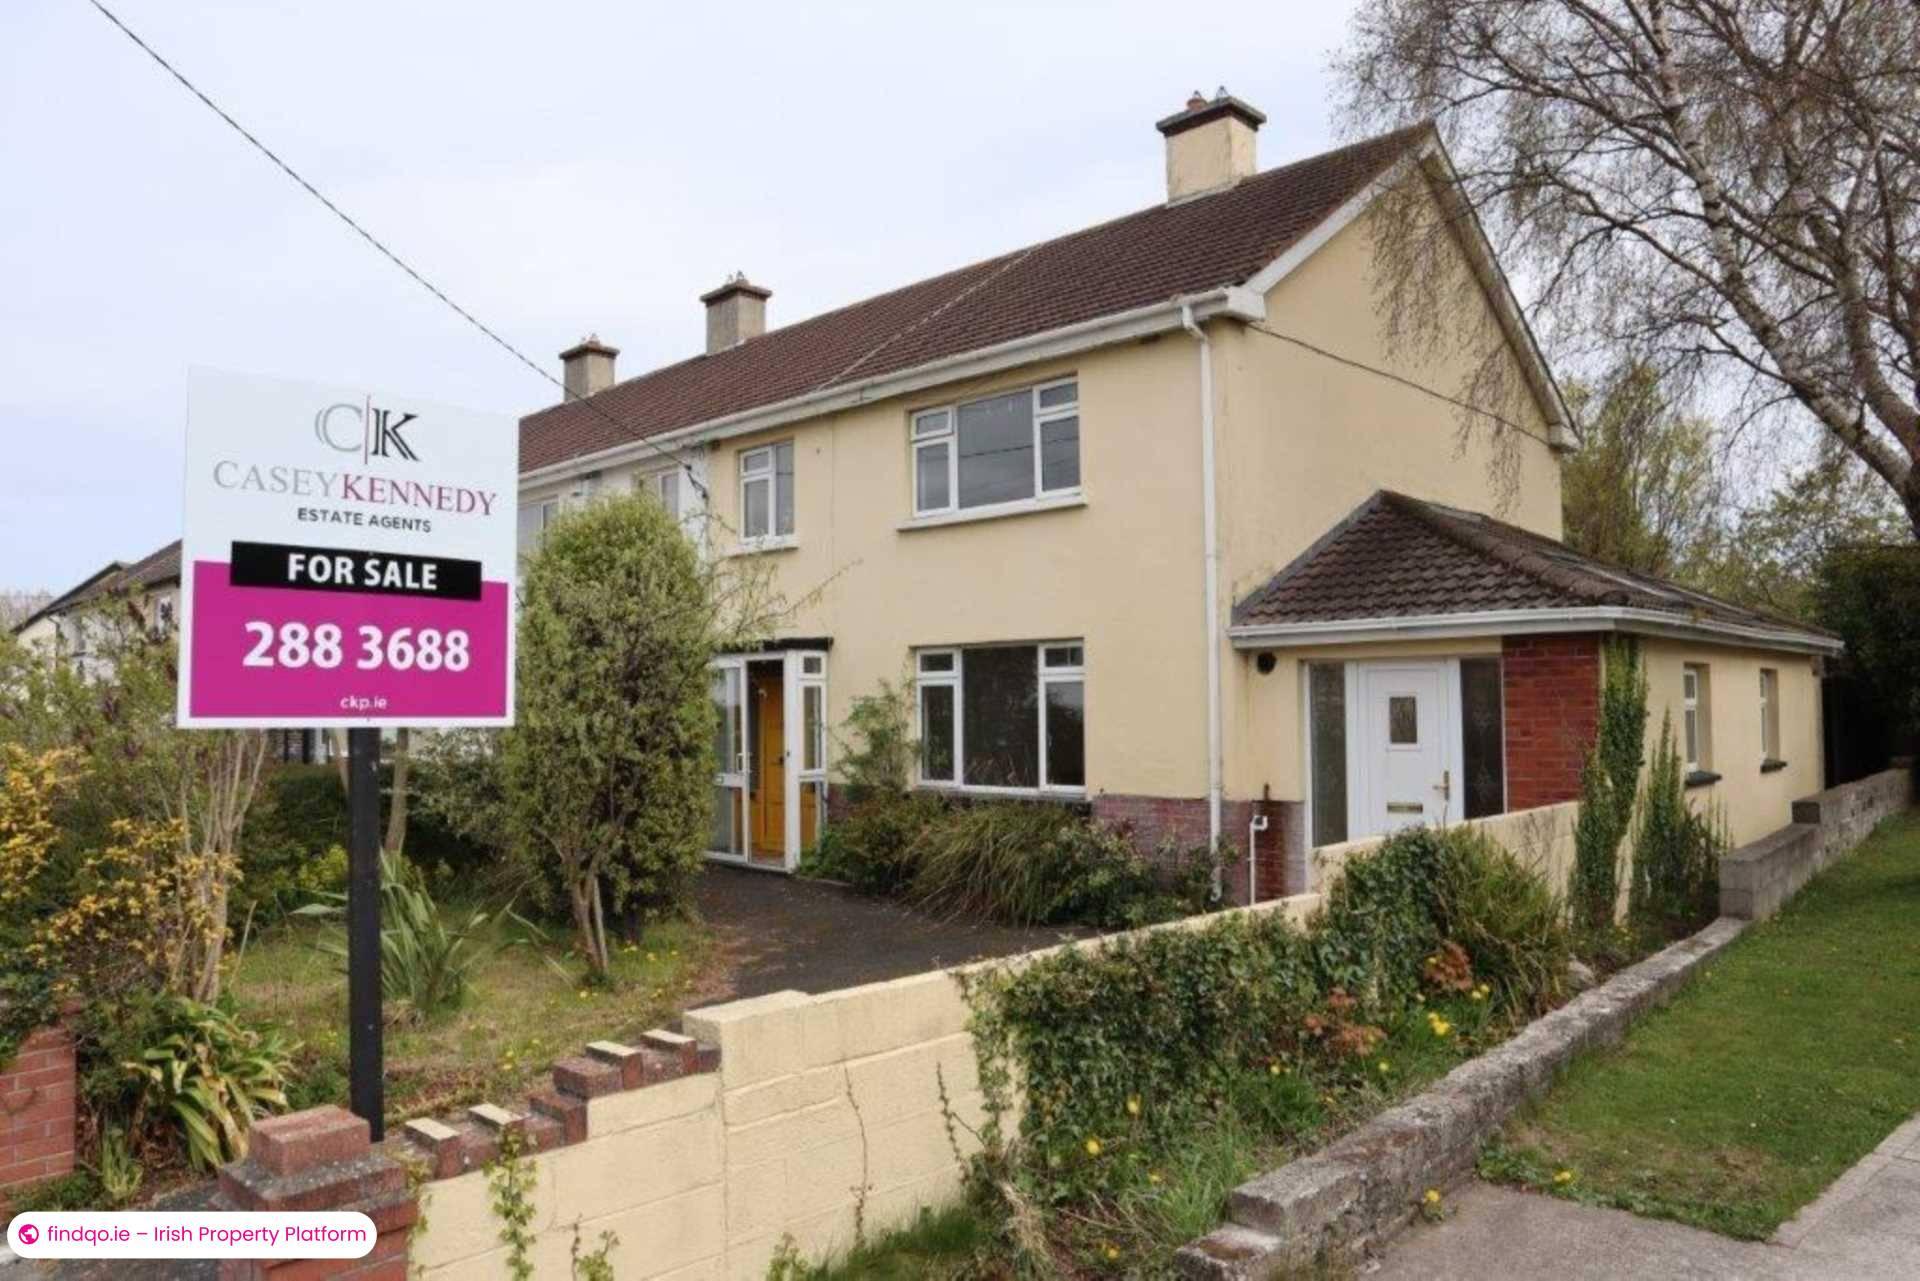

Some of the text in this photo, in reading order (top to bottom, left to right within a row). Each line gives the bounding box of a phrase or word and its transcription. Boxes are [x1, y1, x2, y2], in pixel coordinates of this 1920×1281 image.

[298, 507, 431, 532] ESTATE AGENTS
[288, 553, 438, 590] FOR SALE
[243, 621, 470, 672] 288 3688
[340, 695, 387, 711] ckp.ie
